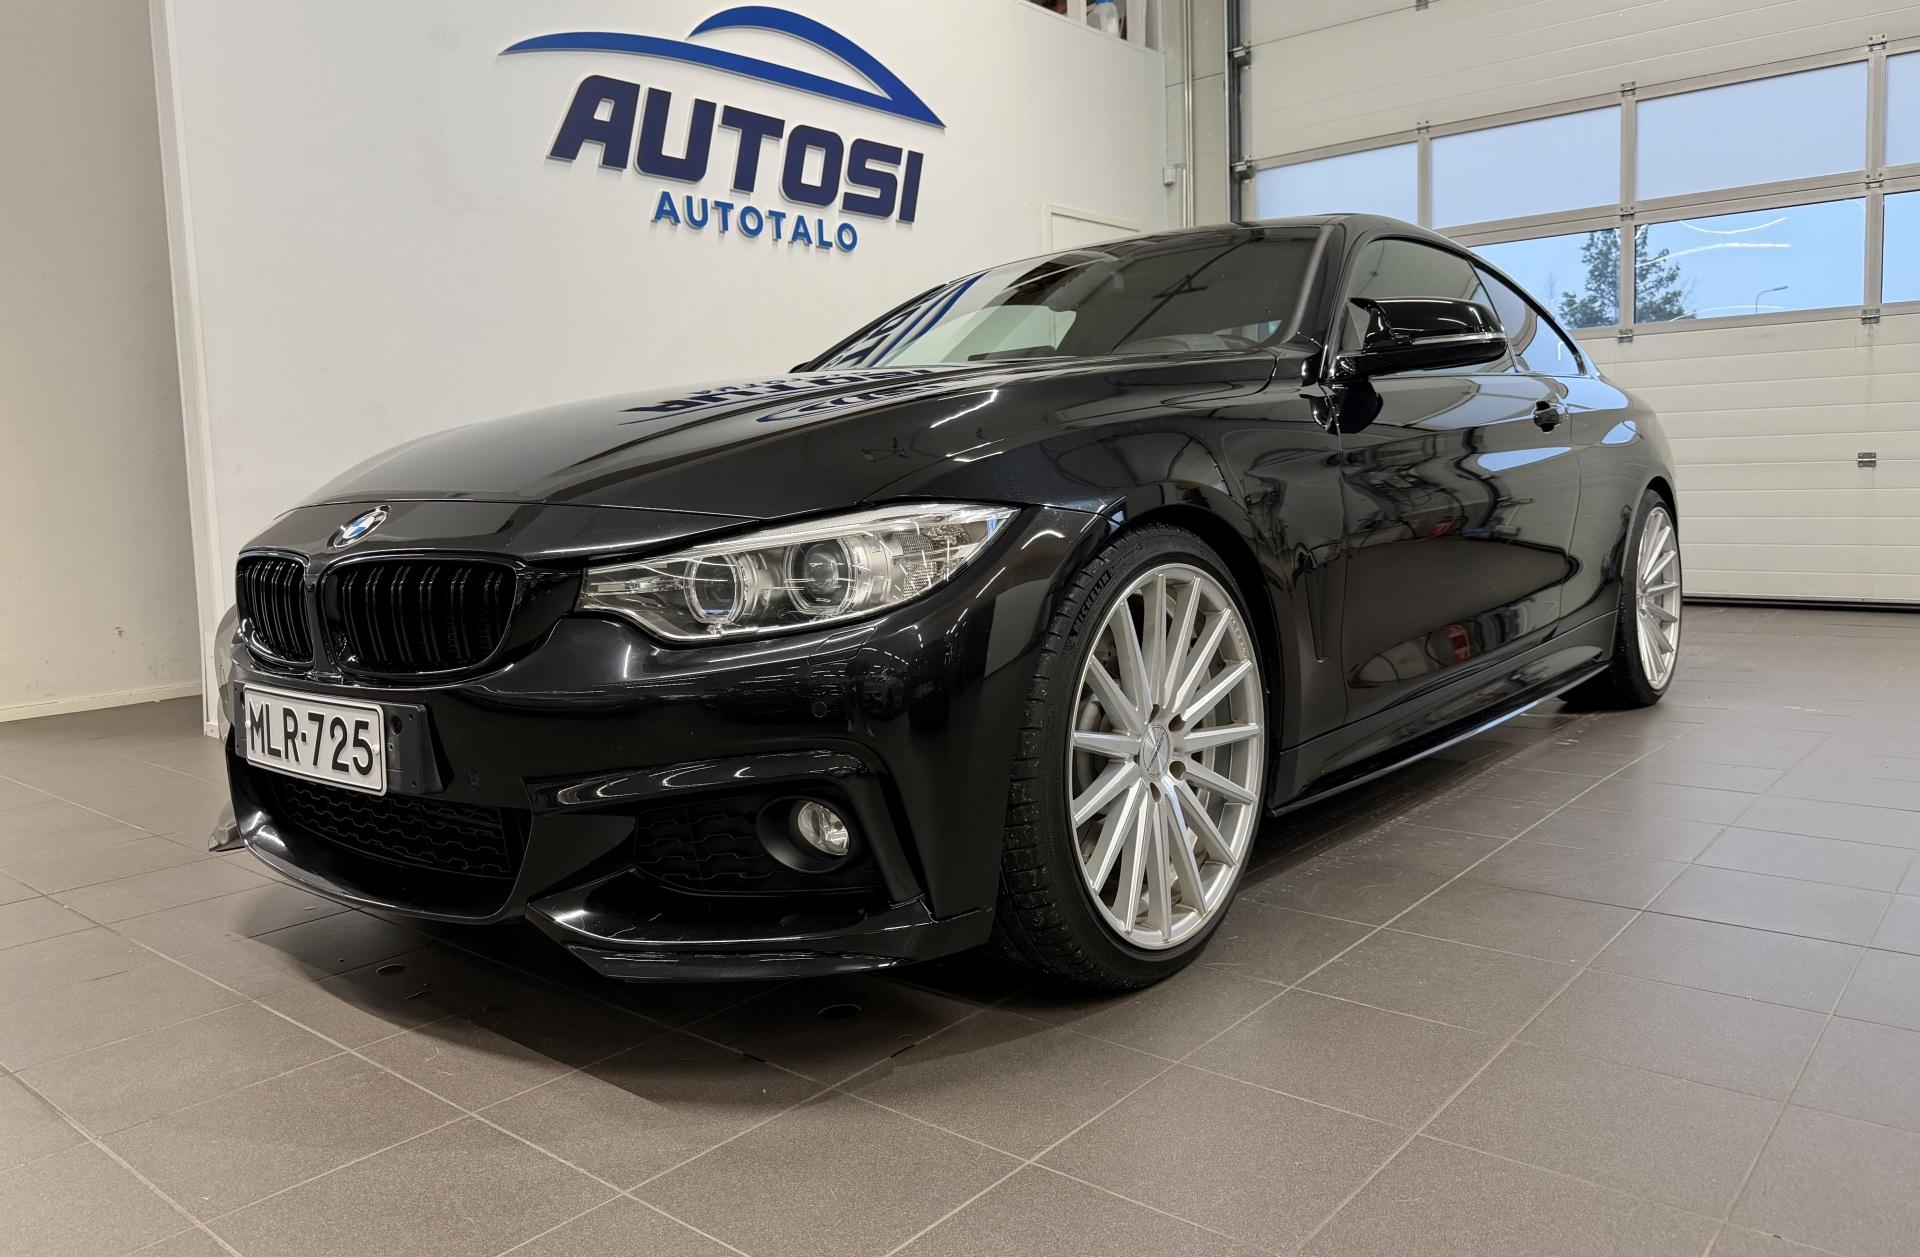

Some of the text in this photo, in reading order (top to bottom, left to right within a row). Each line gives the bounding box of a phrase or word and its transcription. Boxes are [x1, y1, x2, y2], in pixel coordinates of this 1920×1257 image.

[548, 75, 924, 223] AUTOSI
[653, 191, 858, 252] AUTOTALO
[1069, 570, 1111, 636] MICHELIN
[249, 698, 374, 776] MLR-725
